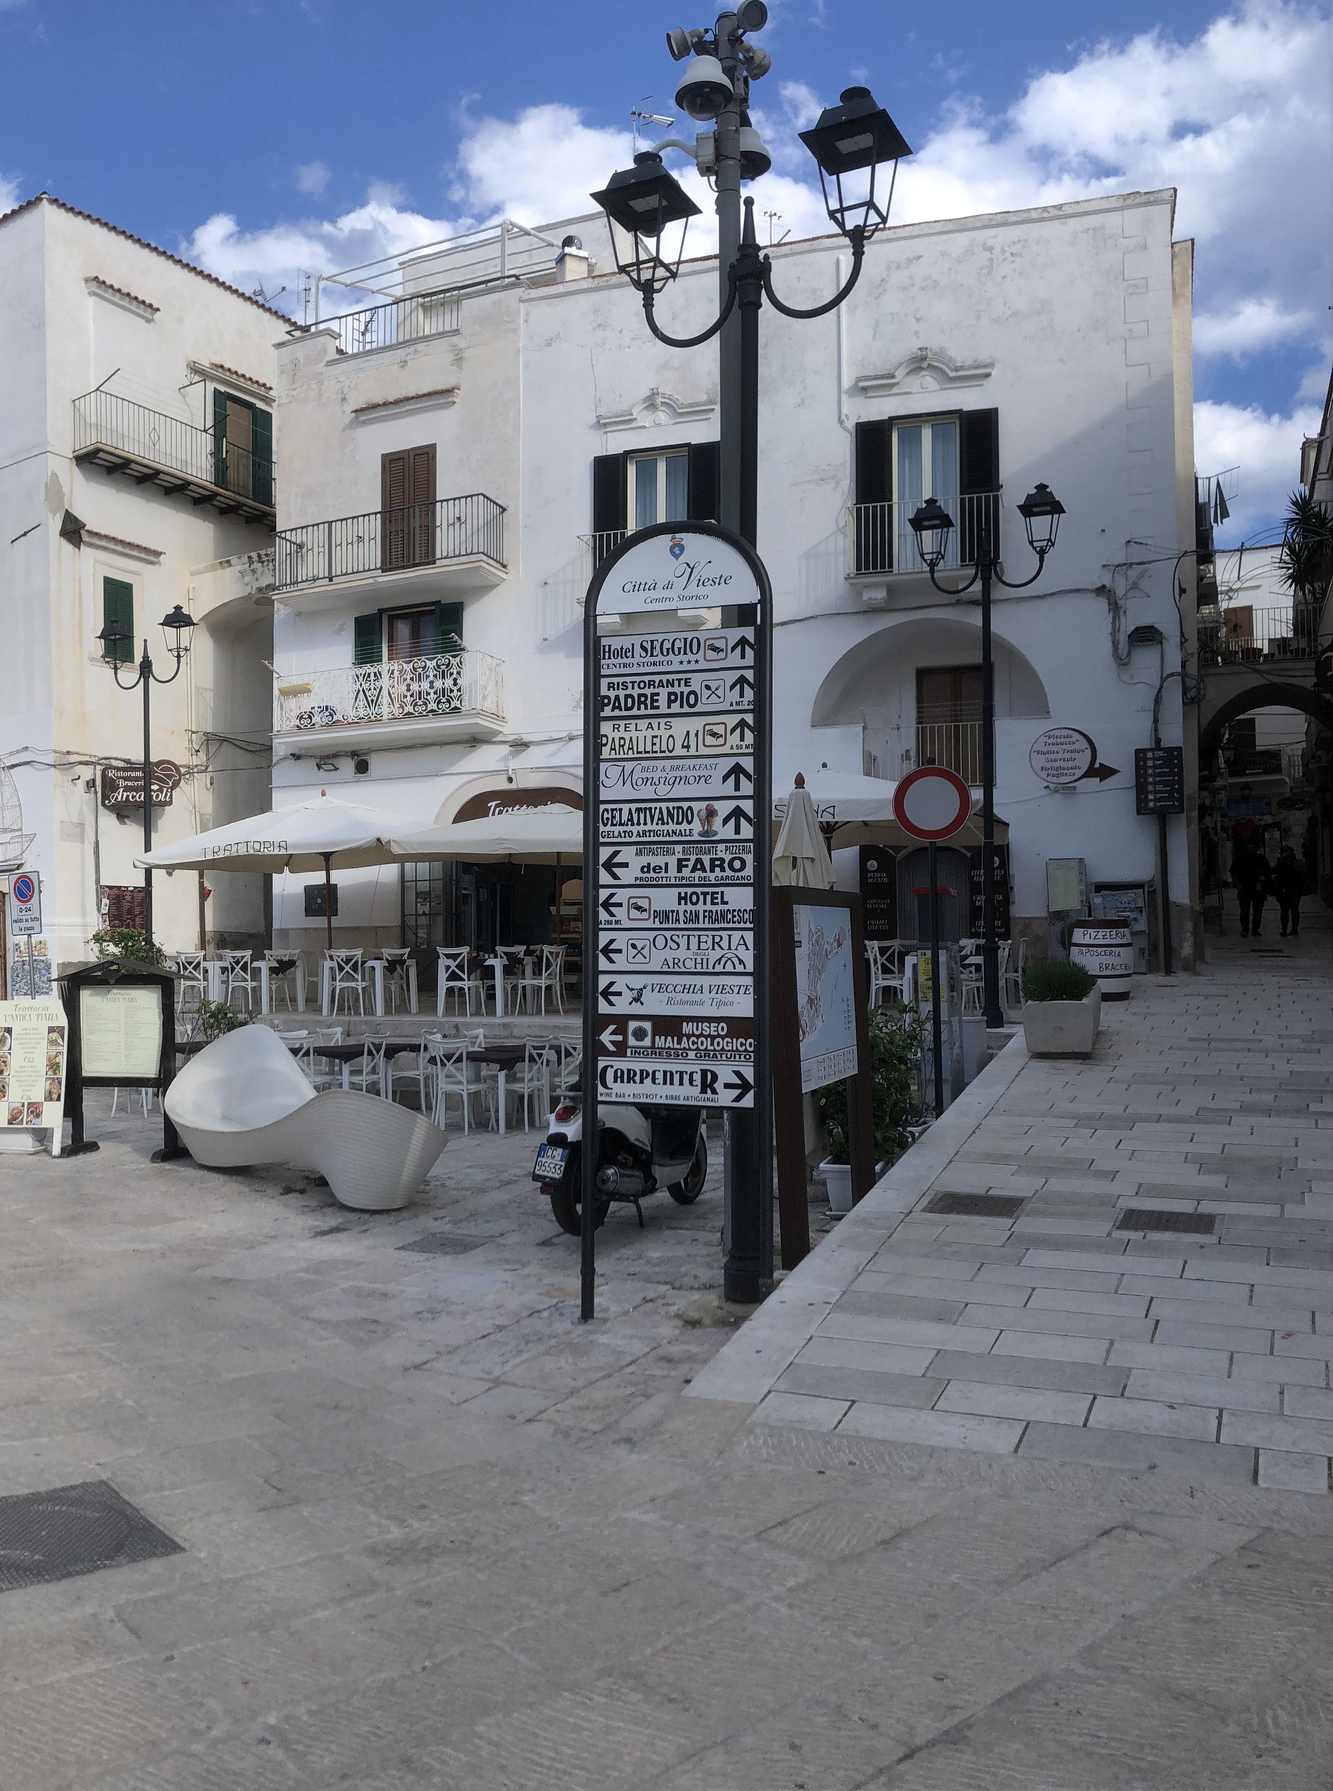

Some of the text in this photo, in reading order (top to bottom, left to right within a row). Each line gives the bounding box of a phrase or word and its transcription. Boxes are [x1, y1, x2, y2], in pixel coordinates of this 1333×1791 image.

[621, 560, 733, 594] Città di Vieste
[643, 593, 709, 605] Centro Storico
[601, 636, 701, 661] Hotel SEGGIO
[601, 659, 673, 670] CENTRO STORICO
[606, 677, 692, 692] RISTORANTE
[600, 689, 700, 713] PADRE PIO
[612, 721, 673, 733] RELAIS
[599, 733, 676, 756] PARALLELO
[640, 763, 719, 774] BED & BREAKFAST
[117, 778, 145, 788] Braceri
[601, 763, 713, 797] Monsignore
[104, 787, 172, 806] Arcaoli
[601, 805, 695, 828] GELATIVANDO
[600, 828, 694, 839] GELATO ARTIGIANALE
[201, 839, 289, 859] TRATTORIA
[634, 846, 676, 857] ANTIPASTERIA
[682, 845, 719, 857] RISTORANTE
[724, 845, 752, 855] PIZZERIA
[640, 856, 747, 875] del FARO
[673, 875, 696, 883] TIPICI
[714, 874, 752, 882] GARGANO
[677, 891, 729, 906] HOTEL
[652, 908, 754, 925] PUNTA SAN FRANCESCO
[652, 933, 750, 951] OSTERIA
[1082, 929, 1128, 941] PIZZERIA
[1077, 948, 1122, 959] PAPOSCERIA
[660, 957, 710, 970] ARCHI
[650, 982, 752, 996] VECCHIA VIESTE
[13, 1003, 50, 1012] Trattoria
[665, 996, 706, 1007] Ristorante
[709, 996, 735, 1010] Tipico
[682, 1021, 728, 1036] MUSEO
[654, 1036, 754, 1051] MALACOLOGICO
[629, 1049, 752, 1061] INGRESSO GRATUITO
[682, 1095, 719, 1103] ARTIGIANALI
[536, 1160, 564, 1176] 95533
